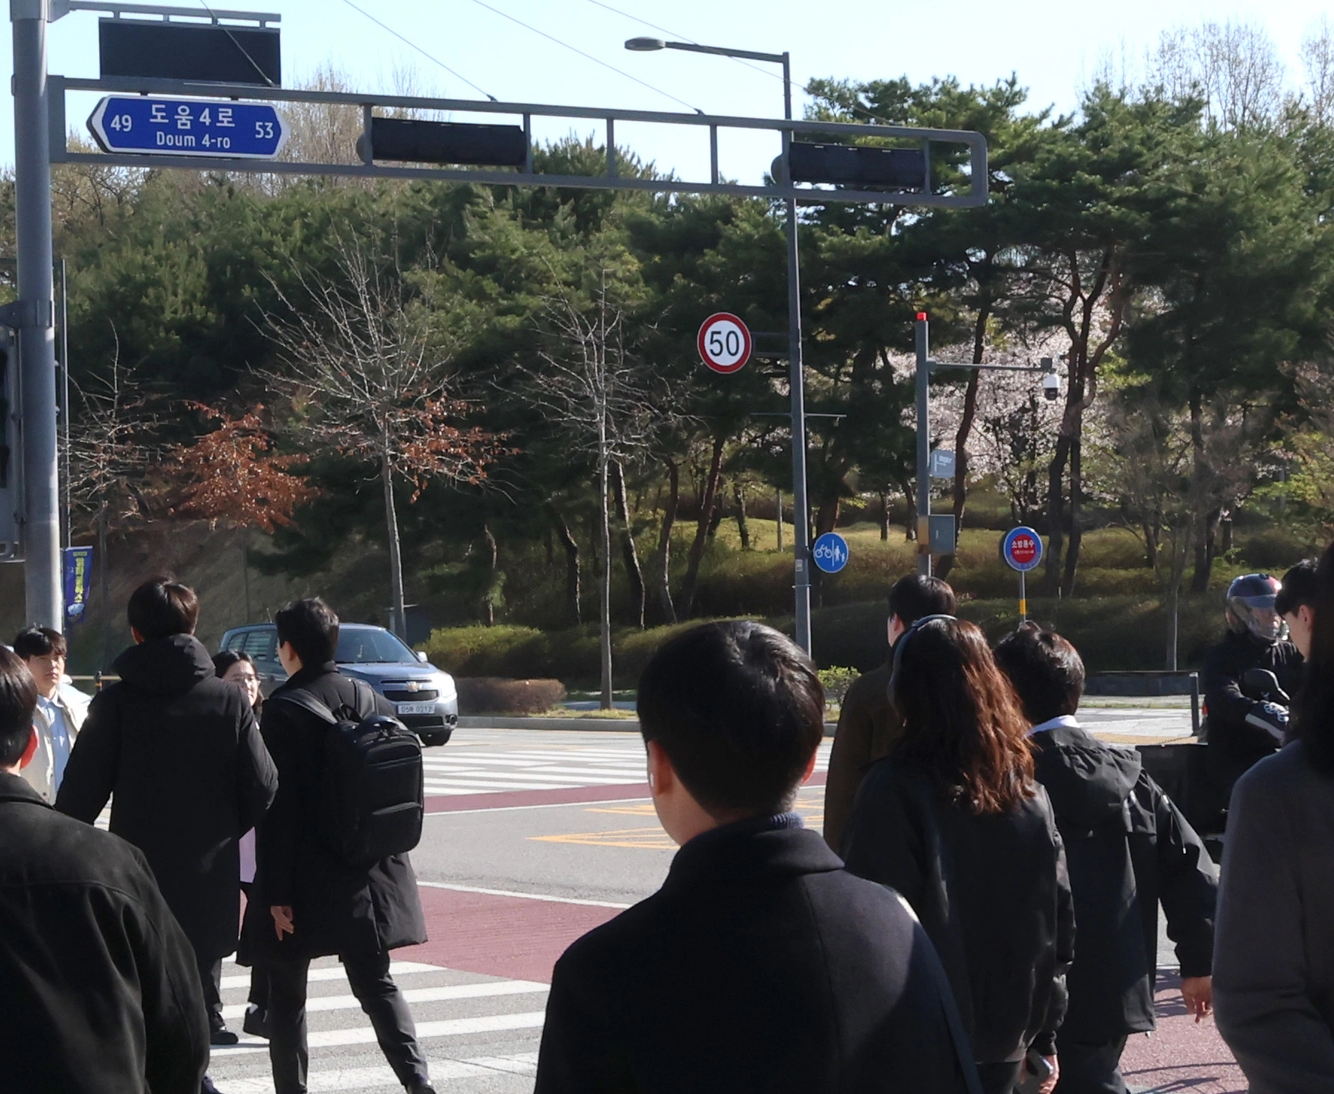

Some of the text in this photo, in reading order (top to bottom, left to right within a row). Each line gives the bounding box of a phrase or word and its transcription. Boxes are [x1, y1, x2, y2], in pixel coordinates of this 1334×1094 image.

[110, 115, 132, 131] 49
[149, 104, 235, 130] 도움4로
[255, 122, 274, 138] 53
[156, 131, 230, 148] Doum 4-ro
[709, 330, 740, 357] 50
